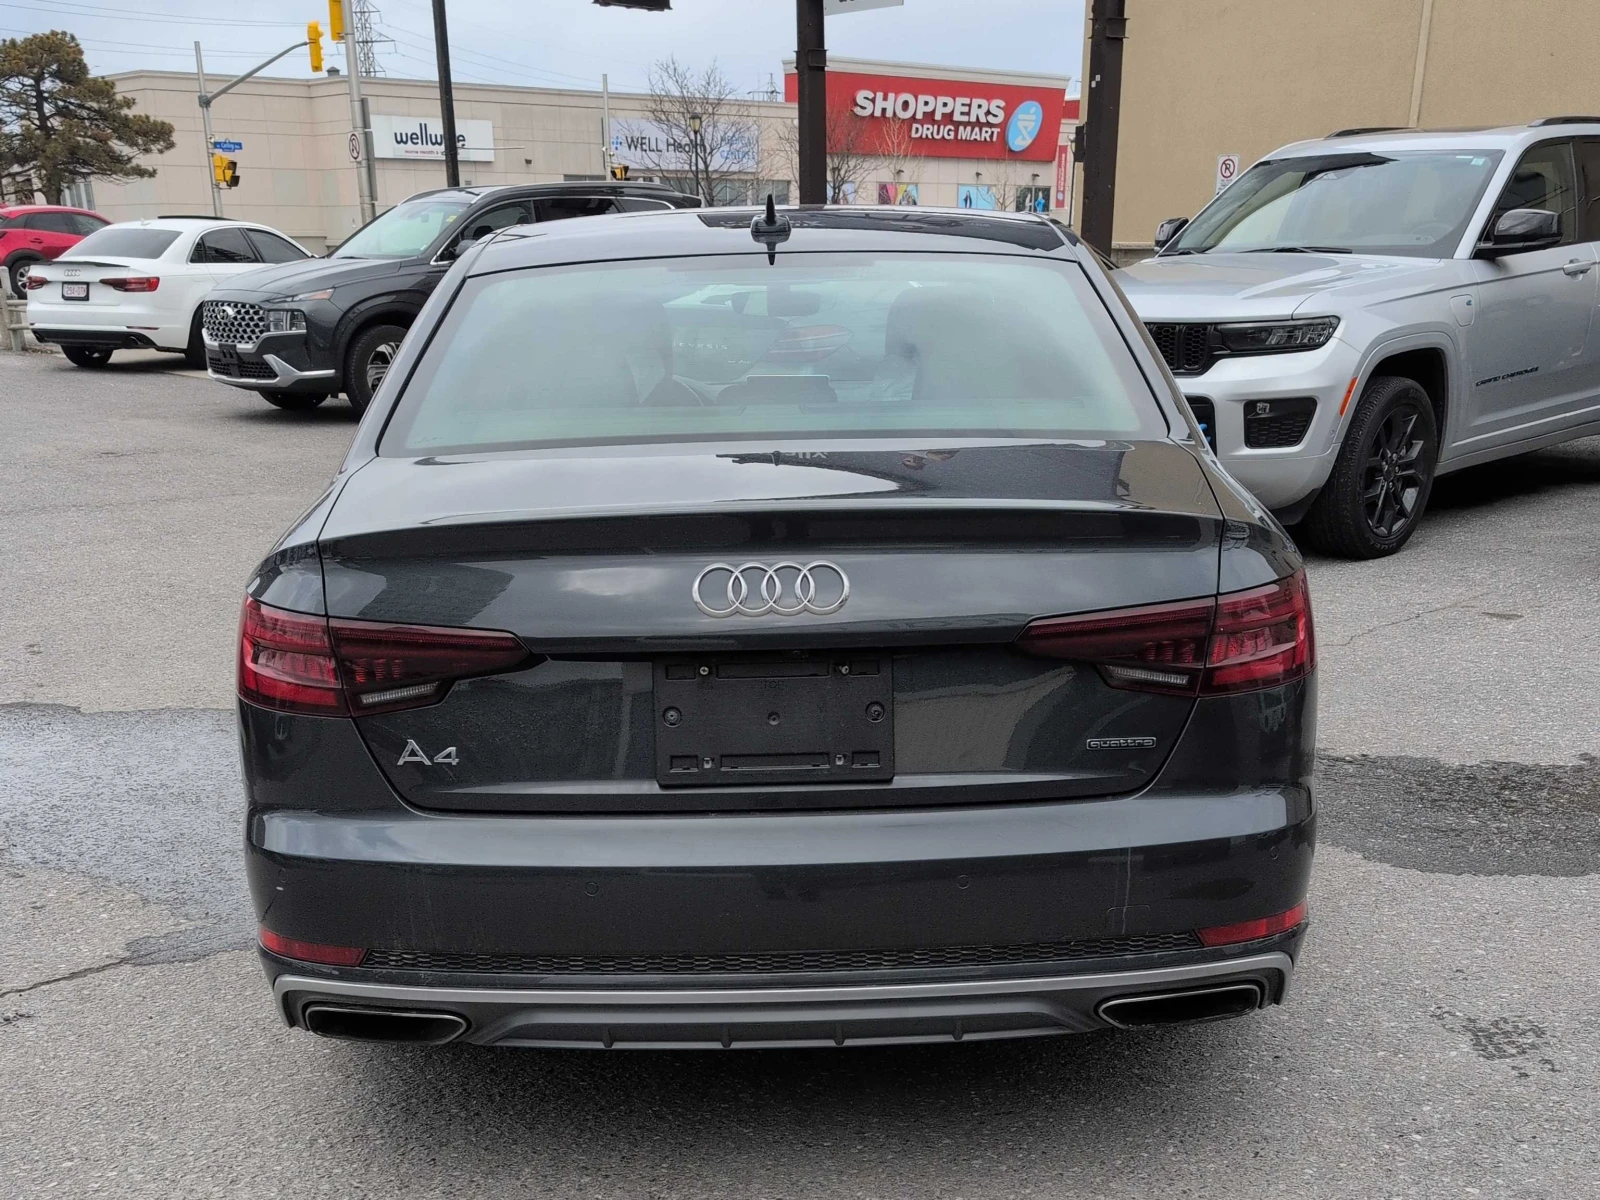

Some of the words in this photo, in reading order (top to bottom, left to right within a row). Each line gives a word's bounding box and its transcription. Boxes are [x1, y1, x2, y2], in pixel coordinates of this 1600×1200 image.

[852, 89, 1006, 125] SHOPPERS
[394, 123, 466, 147] wellwe
[911, 123, 955, 140] DRUG
[957, 126, 1000, 142] MART
[625, 135, 663, 153] WELL
[397, 739, 460, 766] A4
[1090, 739, 1153, 749] quattro
